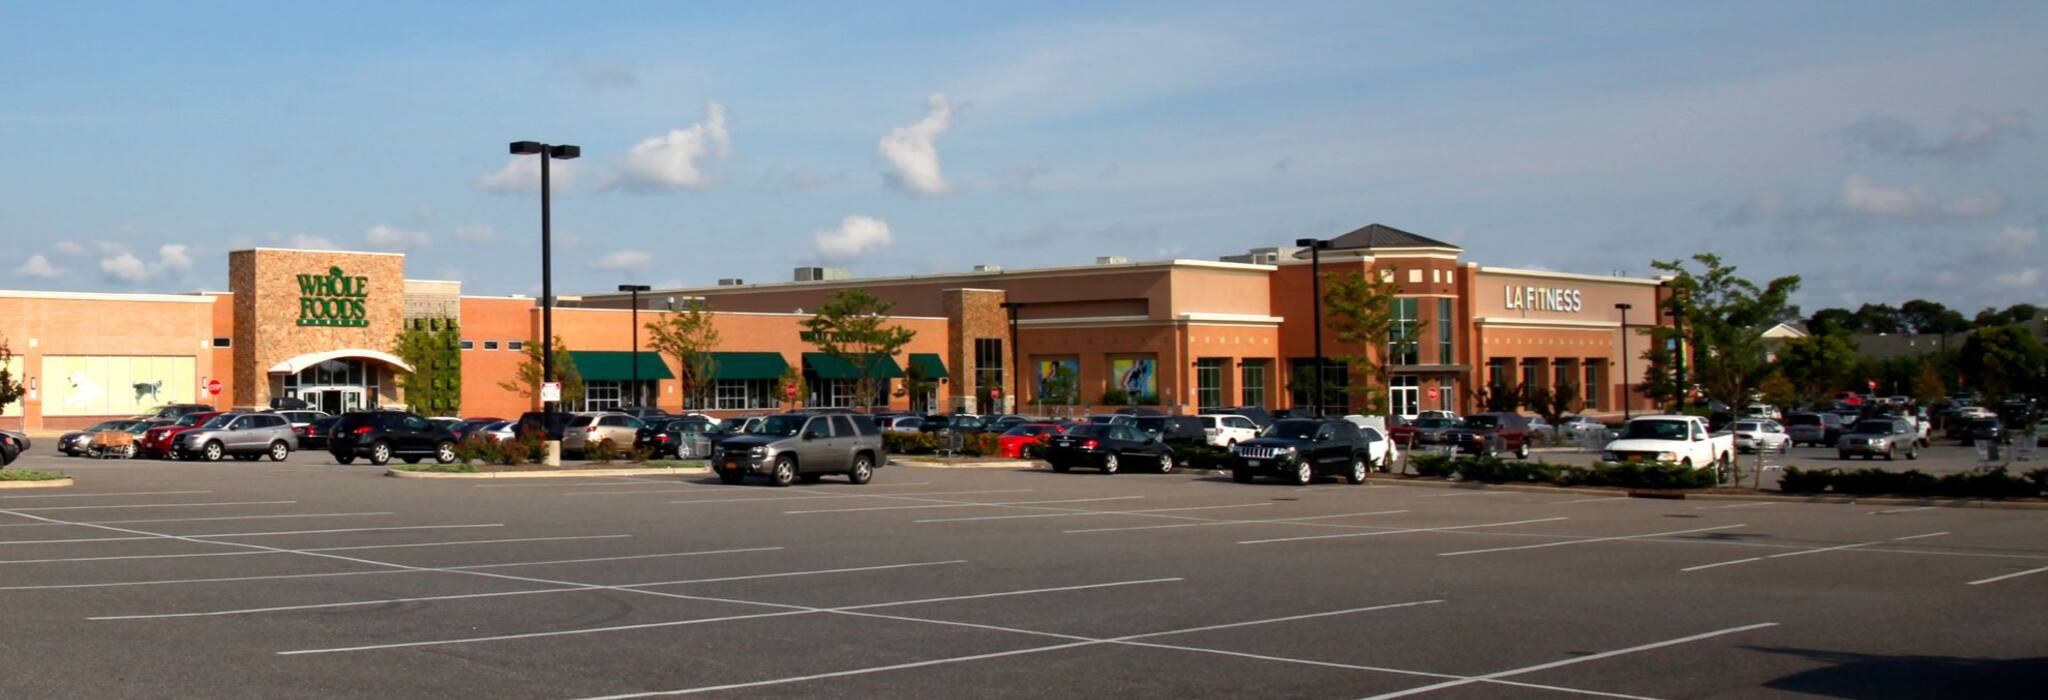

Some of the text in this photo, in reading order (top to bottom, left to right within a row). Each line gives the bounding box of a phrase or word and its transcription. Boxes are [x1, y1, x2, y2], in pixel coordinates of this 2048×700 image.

[296, 274, 368, 297] WHOLE
[299, 297, 366, 320] FOODS
[1505, 285, 1581, 312] LA FITNESS
